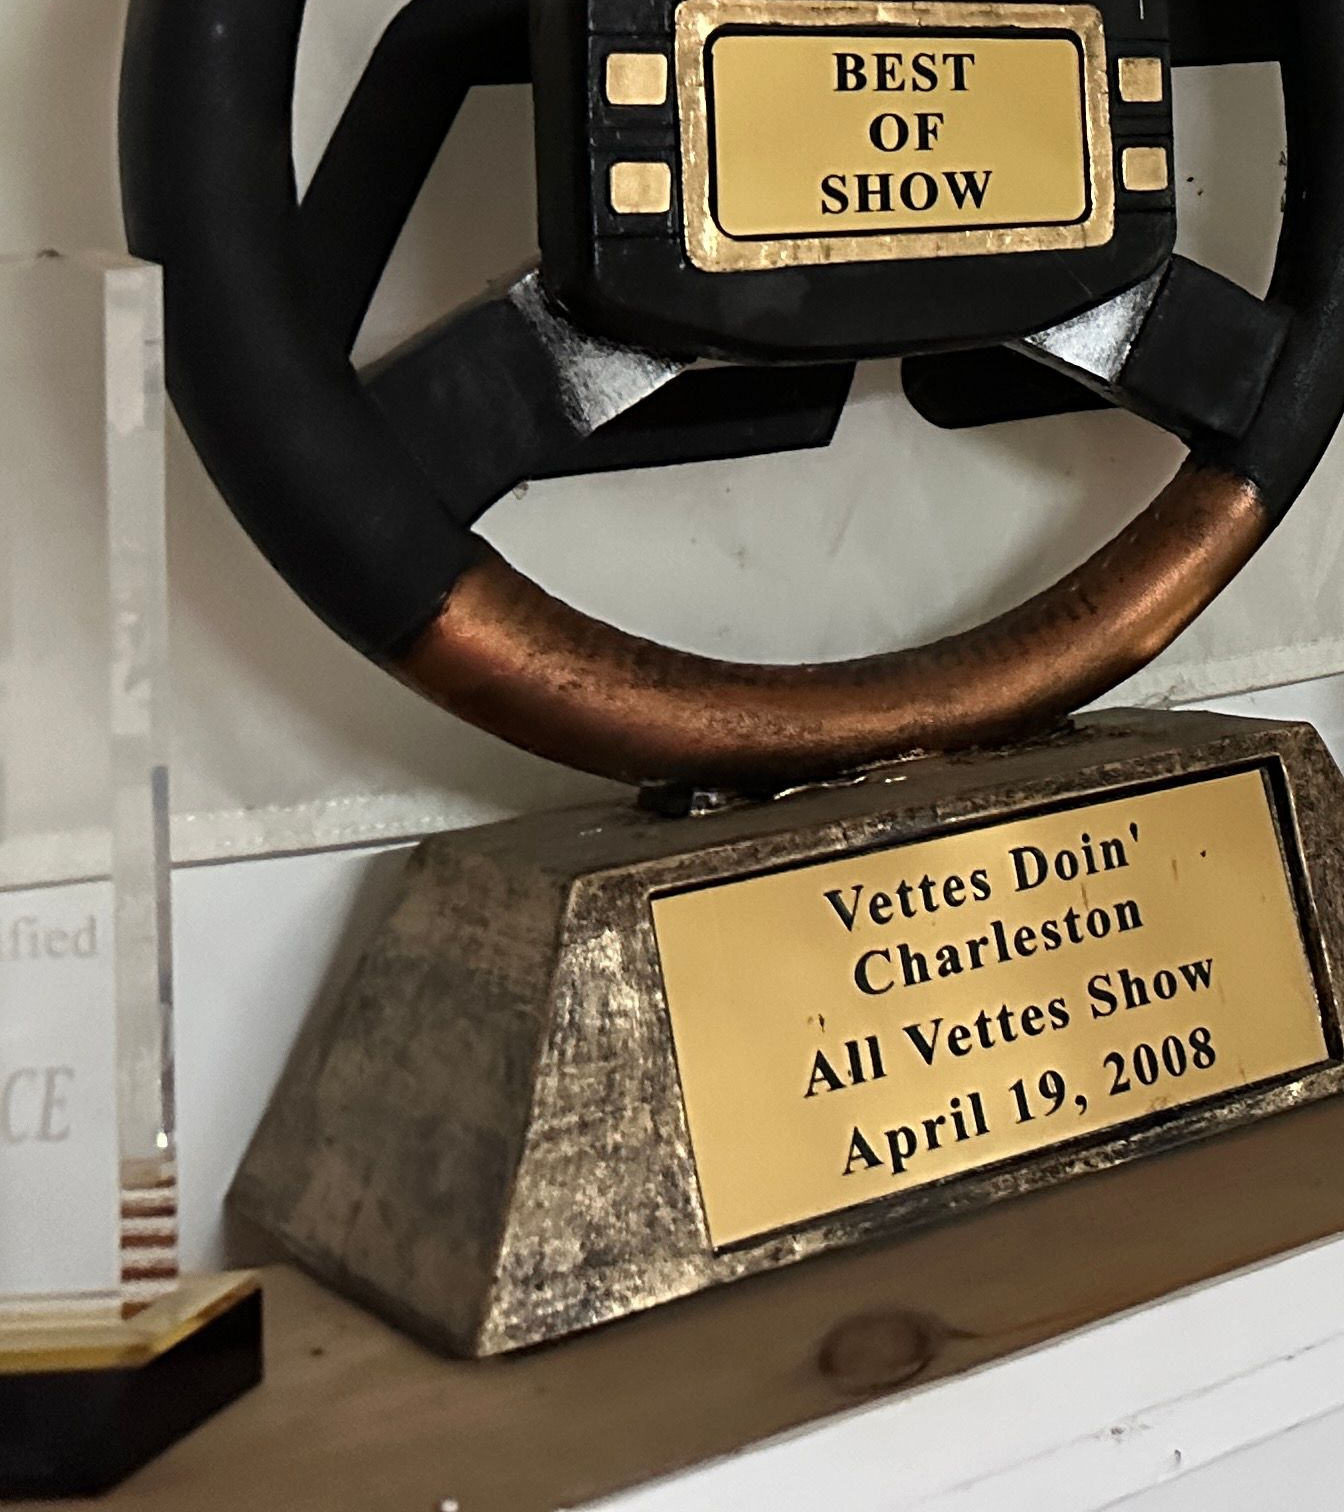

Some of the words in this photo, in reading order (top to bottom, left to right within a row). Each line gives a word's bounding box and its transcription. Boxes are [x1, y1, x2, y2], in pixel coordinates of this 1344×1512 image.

[833, 52, 976, 93] BEST
[869, 112, 945, 152] OF
[820, 169, 993, 215] SHOW
[823, 865, 993, 934] Vettes
[1008, 822, 1140, 893] Doin'
[853, 898, 1144, 996] Charleston
[803, 1035, 885, 1098] All
[903, 994, 1070, 1065] Vettes
[1089, 957, 1216, 1021] Show
[842, 1091, 989, 1176] April
[1009, 1069, 1087, 1124] 19,
[1103, 1025, 1218, 1095] 2008
